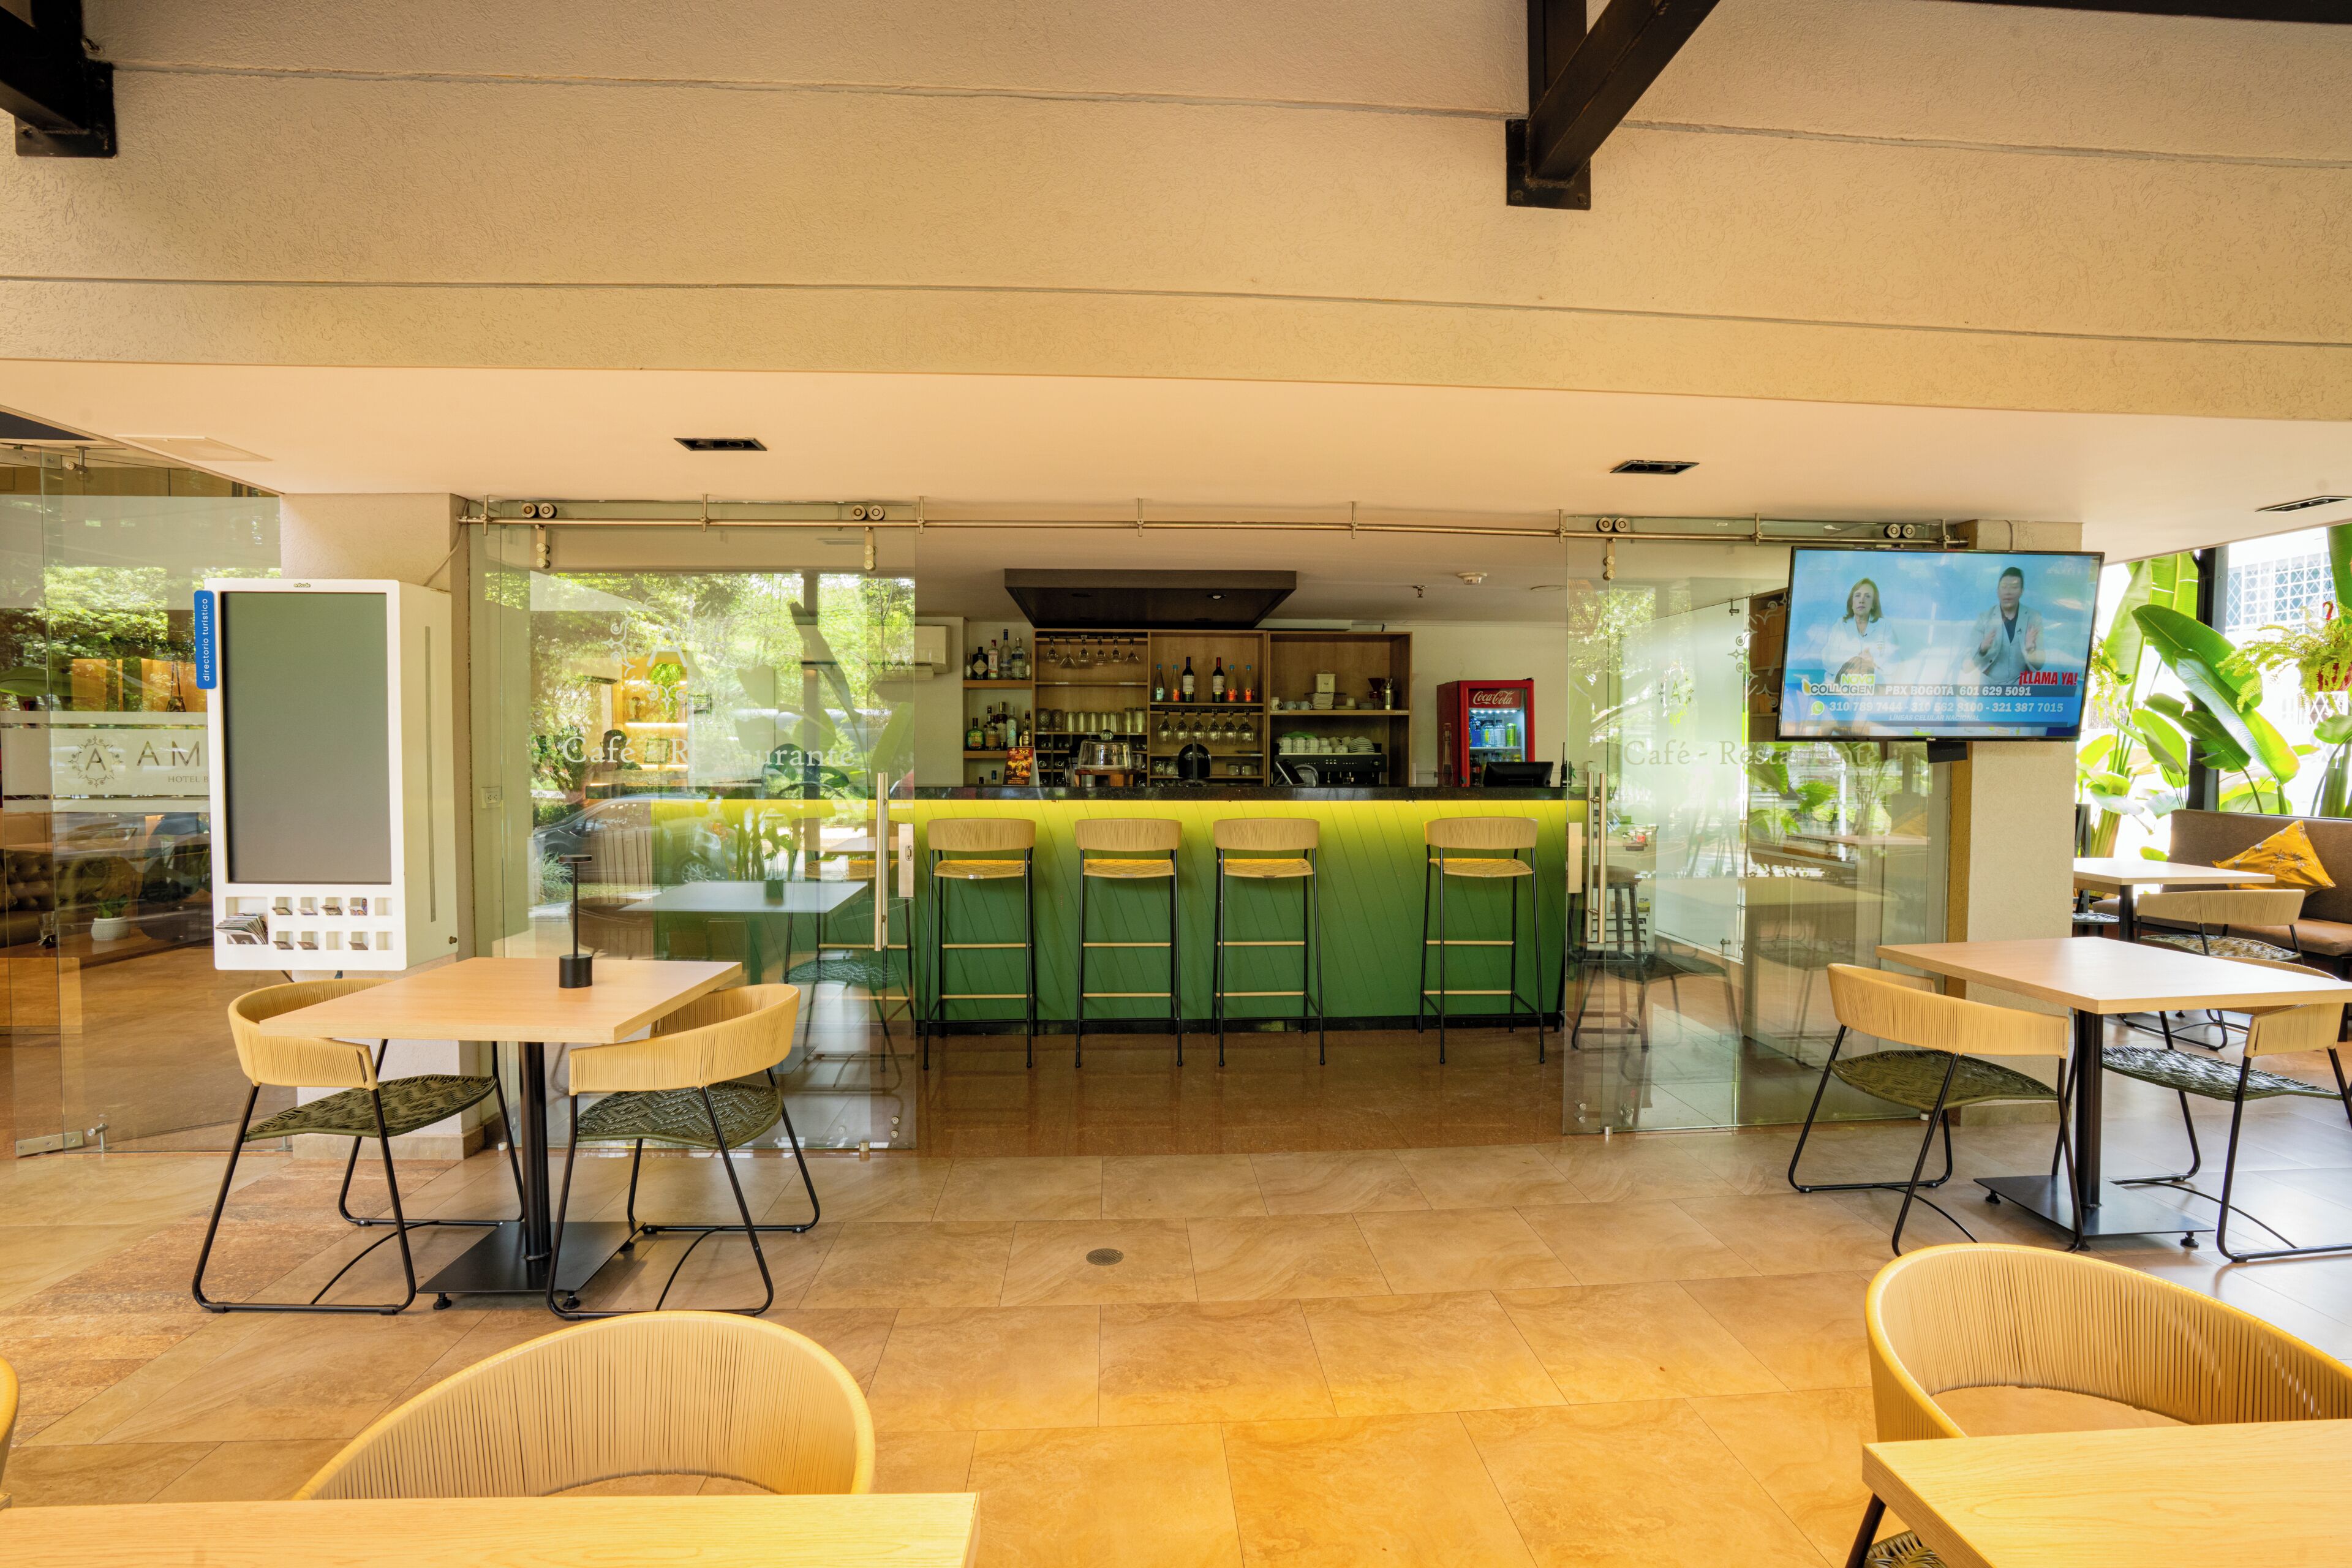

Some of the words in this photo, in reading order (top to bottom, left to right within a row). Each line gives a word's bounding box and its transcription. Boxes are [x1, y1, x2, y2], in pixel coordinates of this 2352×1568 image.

[2062, 671, 2078, 686] YA!
[1885, 685, 1908, 695] PBX
[1910, 684, 1954, 696] BOGOTÁ
[1959, 685, 1980, 696] 601
[1982, 686, 2002, 696] 629
[2005, 686, 2032, 696] 5091
[1829, 701, 1850, 711] 310
[1910, 702, 1931, 712] 310
[1992, 703, 2012, 712] 321
[2015, 703, 2035, 712] 387
[2037, 703, 2064, 712] 7015
[562, 734, 635, 764] Café
[1623, 739, 1691, 766] Café
